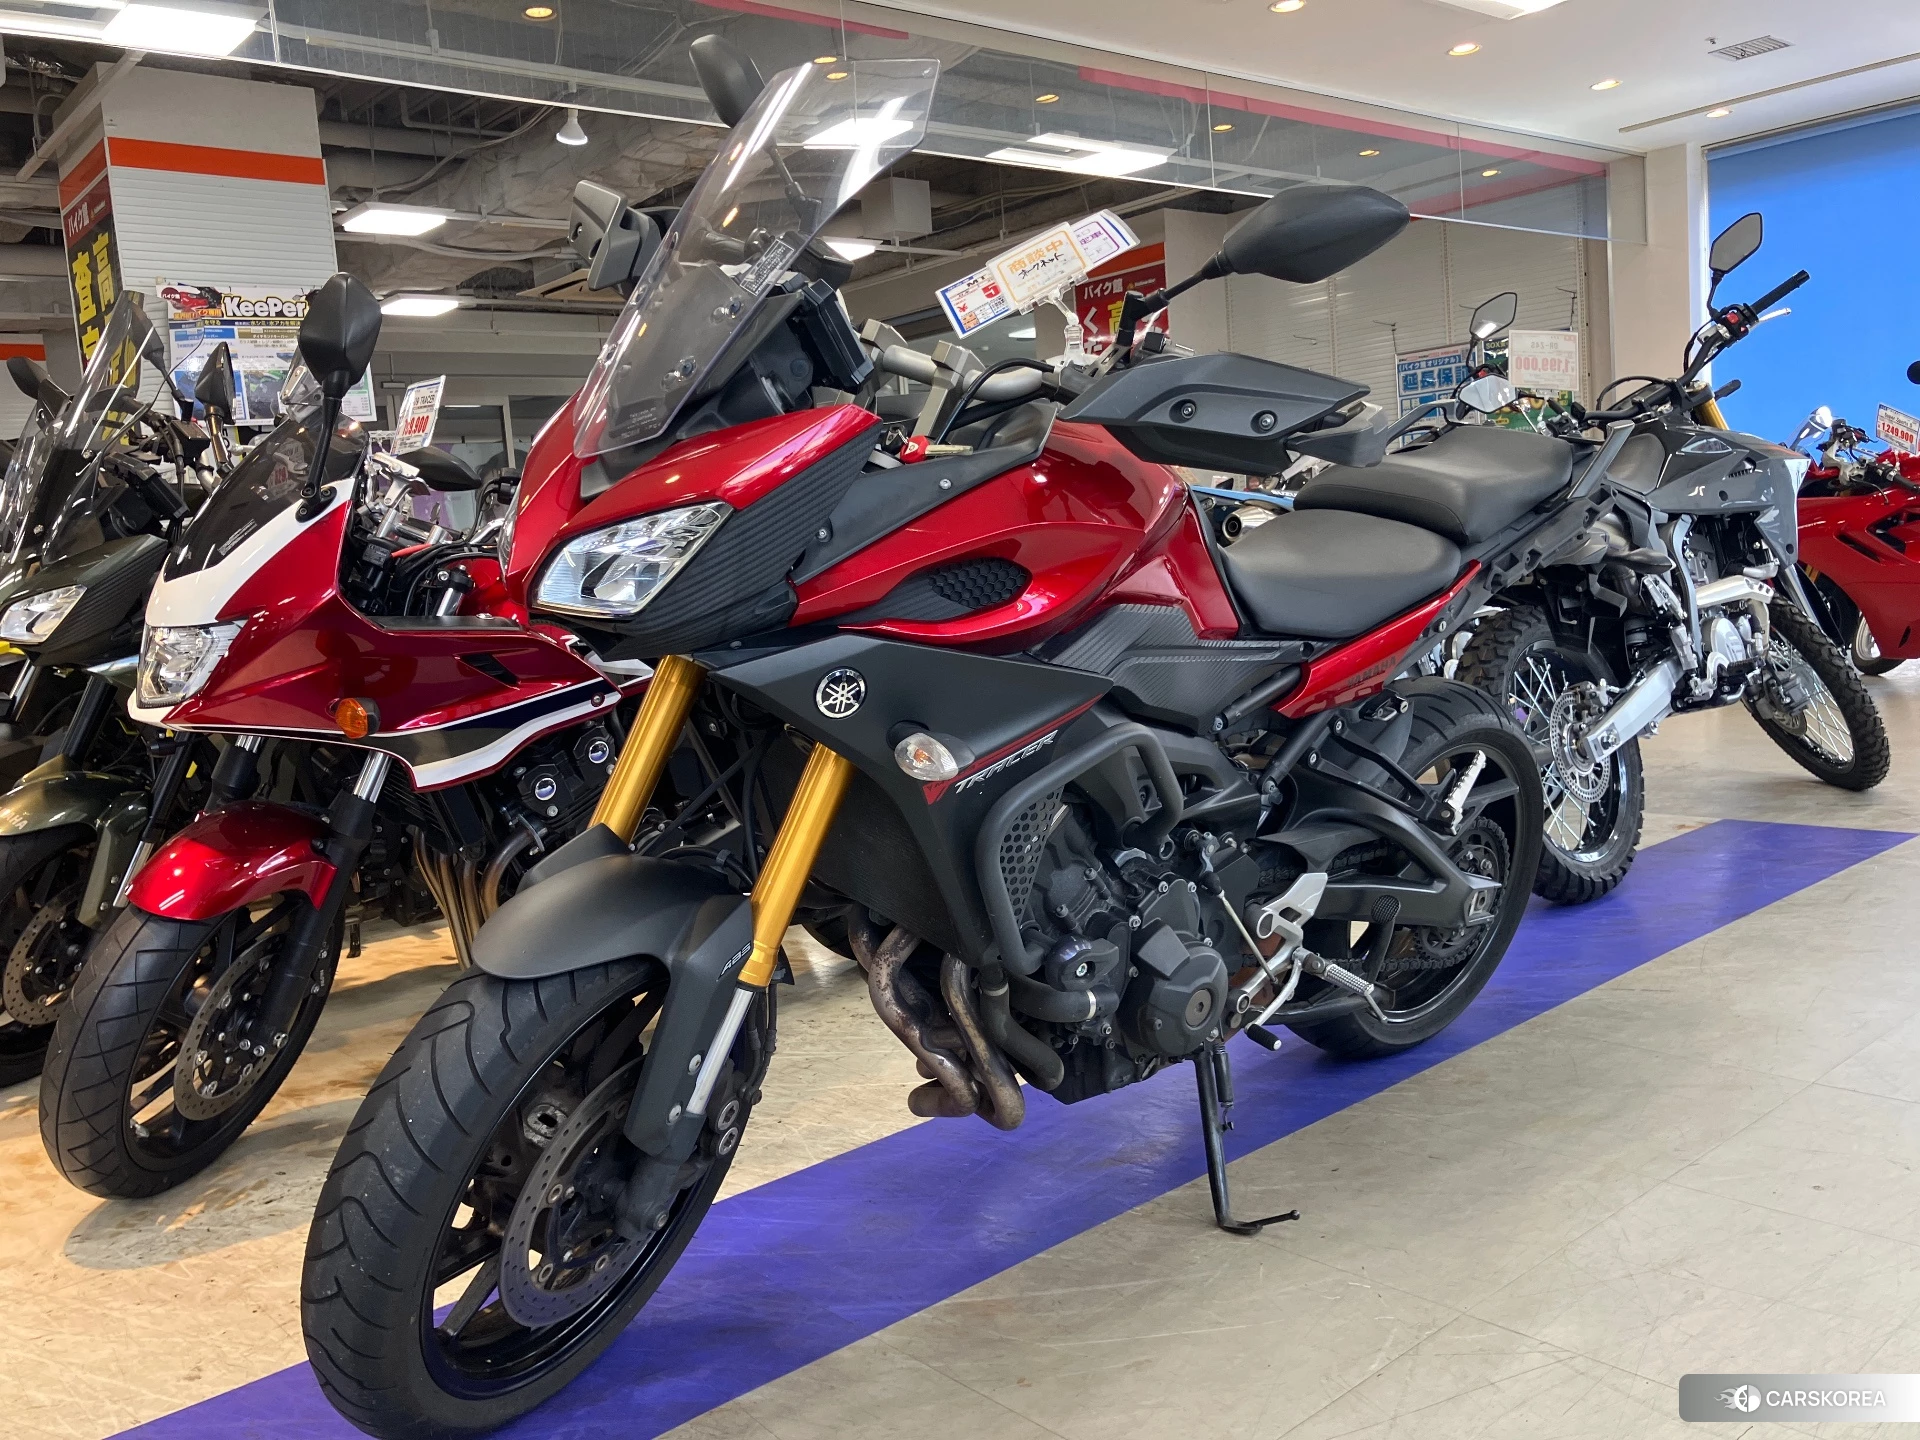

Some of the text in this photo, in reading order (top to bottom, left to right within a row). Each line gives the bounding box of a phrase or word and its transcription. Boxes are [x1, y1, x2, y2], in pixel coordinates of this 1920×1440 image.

[1007, 239, 1063, 274] 商談中
[1083, 277, 1123, 300] バイク館
[223, 295, 306, 318] KeePer
[954, 729, 1059, 794] TRACER
[720, 942, 751, 976] ABS
